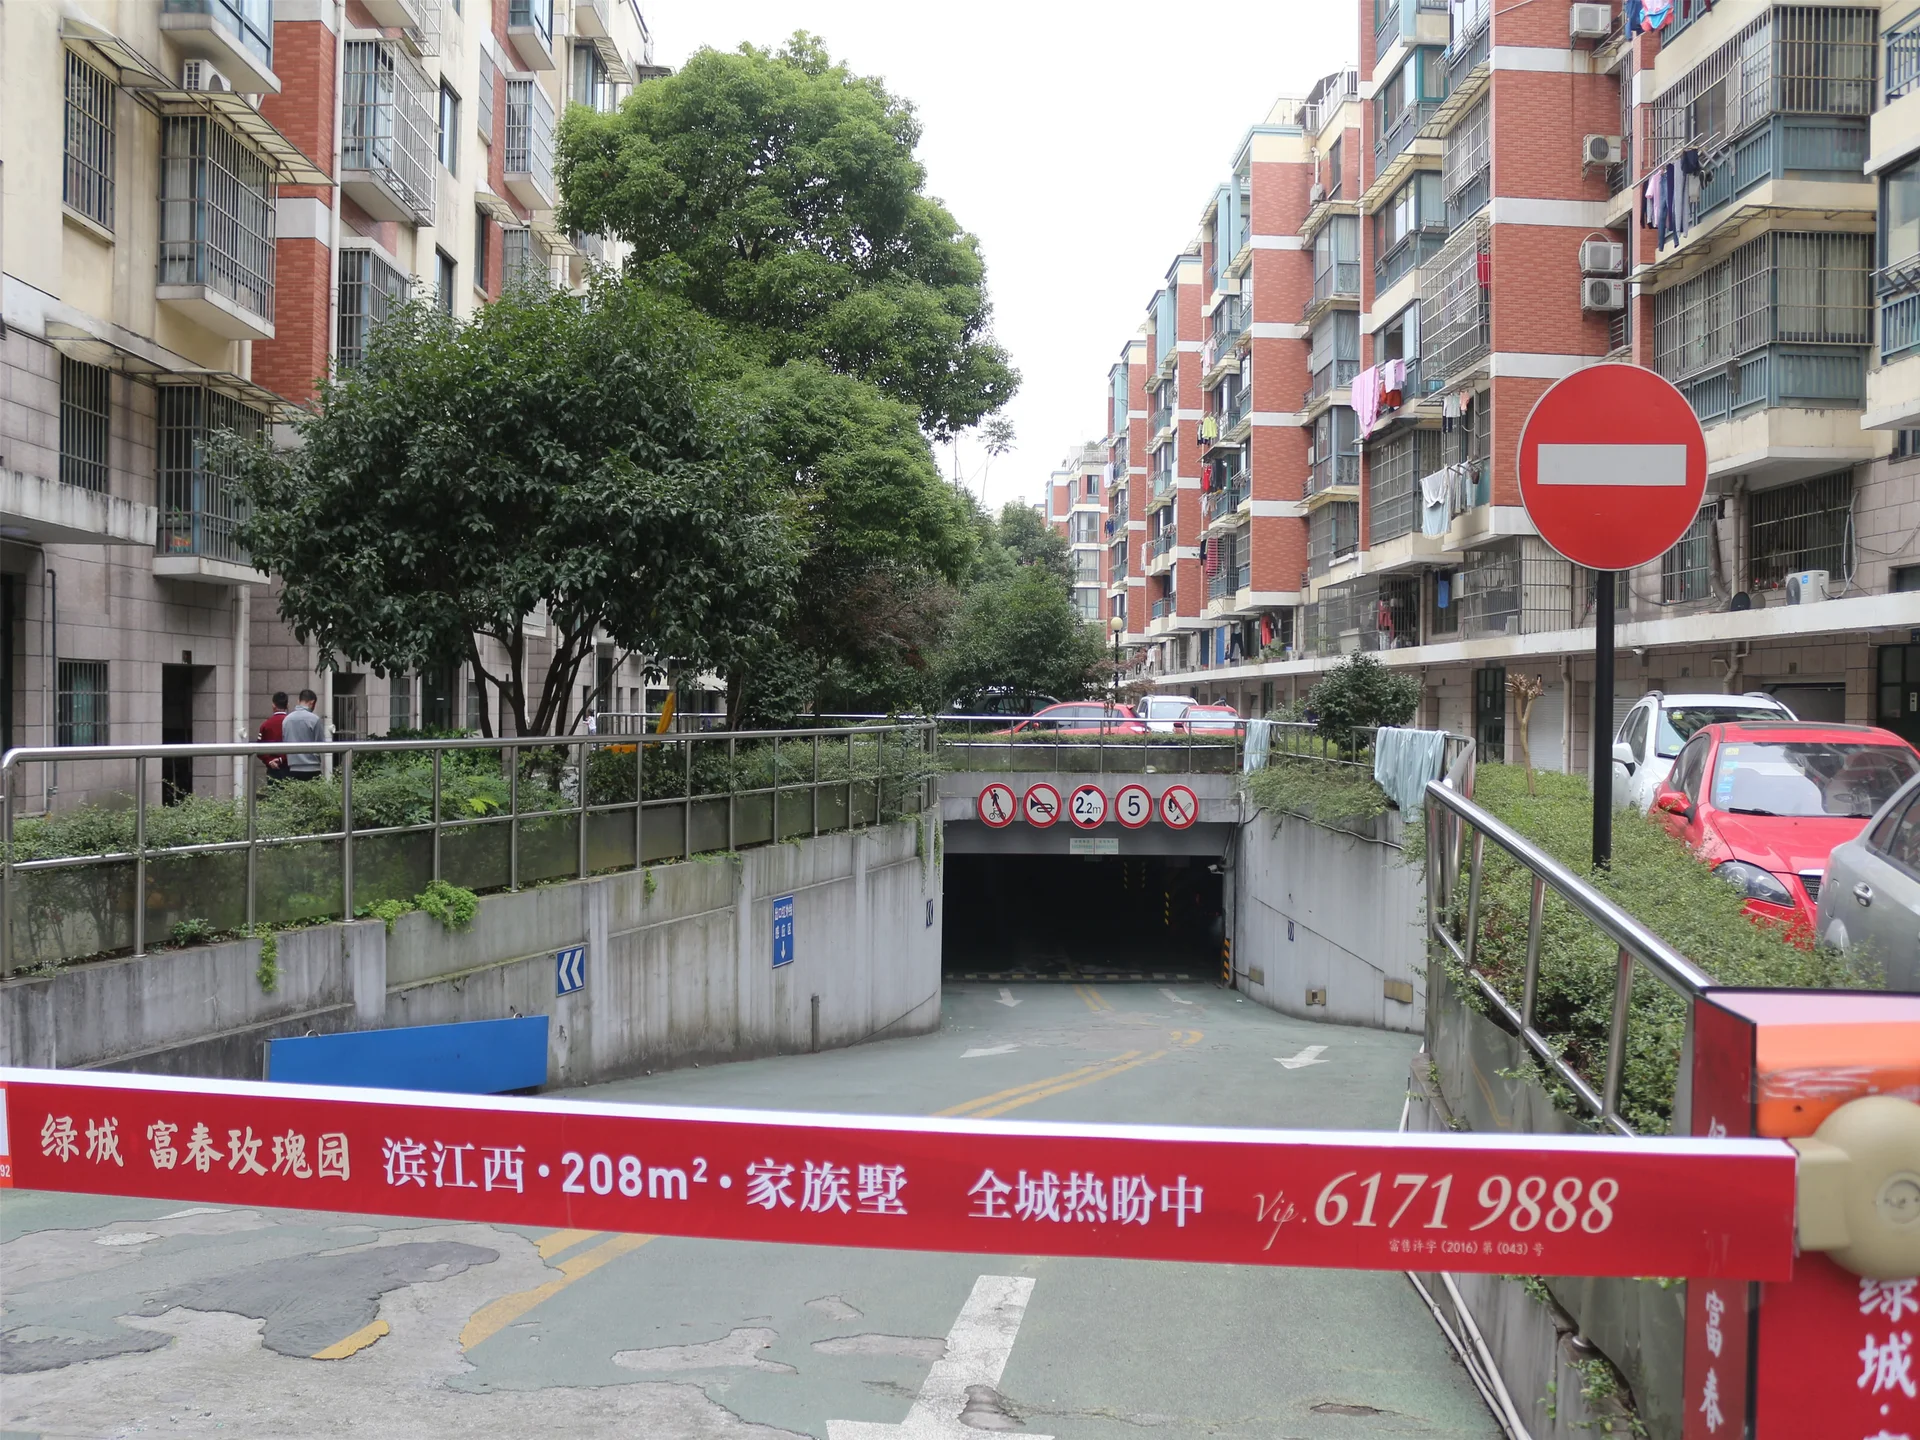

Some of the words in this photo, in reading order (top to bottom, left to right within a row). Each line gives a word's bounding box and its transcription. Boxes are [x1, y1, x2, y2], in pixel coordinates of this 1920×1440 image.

[1127, 795, 1141, 817] 5
[40, 1113, 123, 1168] 绿城
[146, 1119, 350, 1181] 富春玫瑰园
[967, 1168, 1204, 1228] 全城热盼中
[1314, 1171, 1452, 1229] 6171
[1469, 1175, 1619, 1234] 9888
